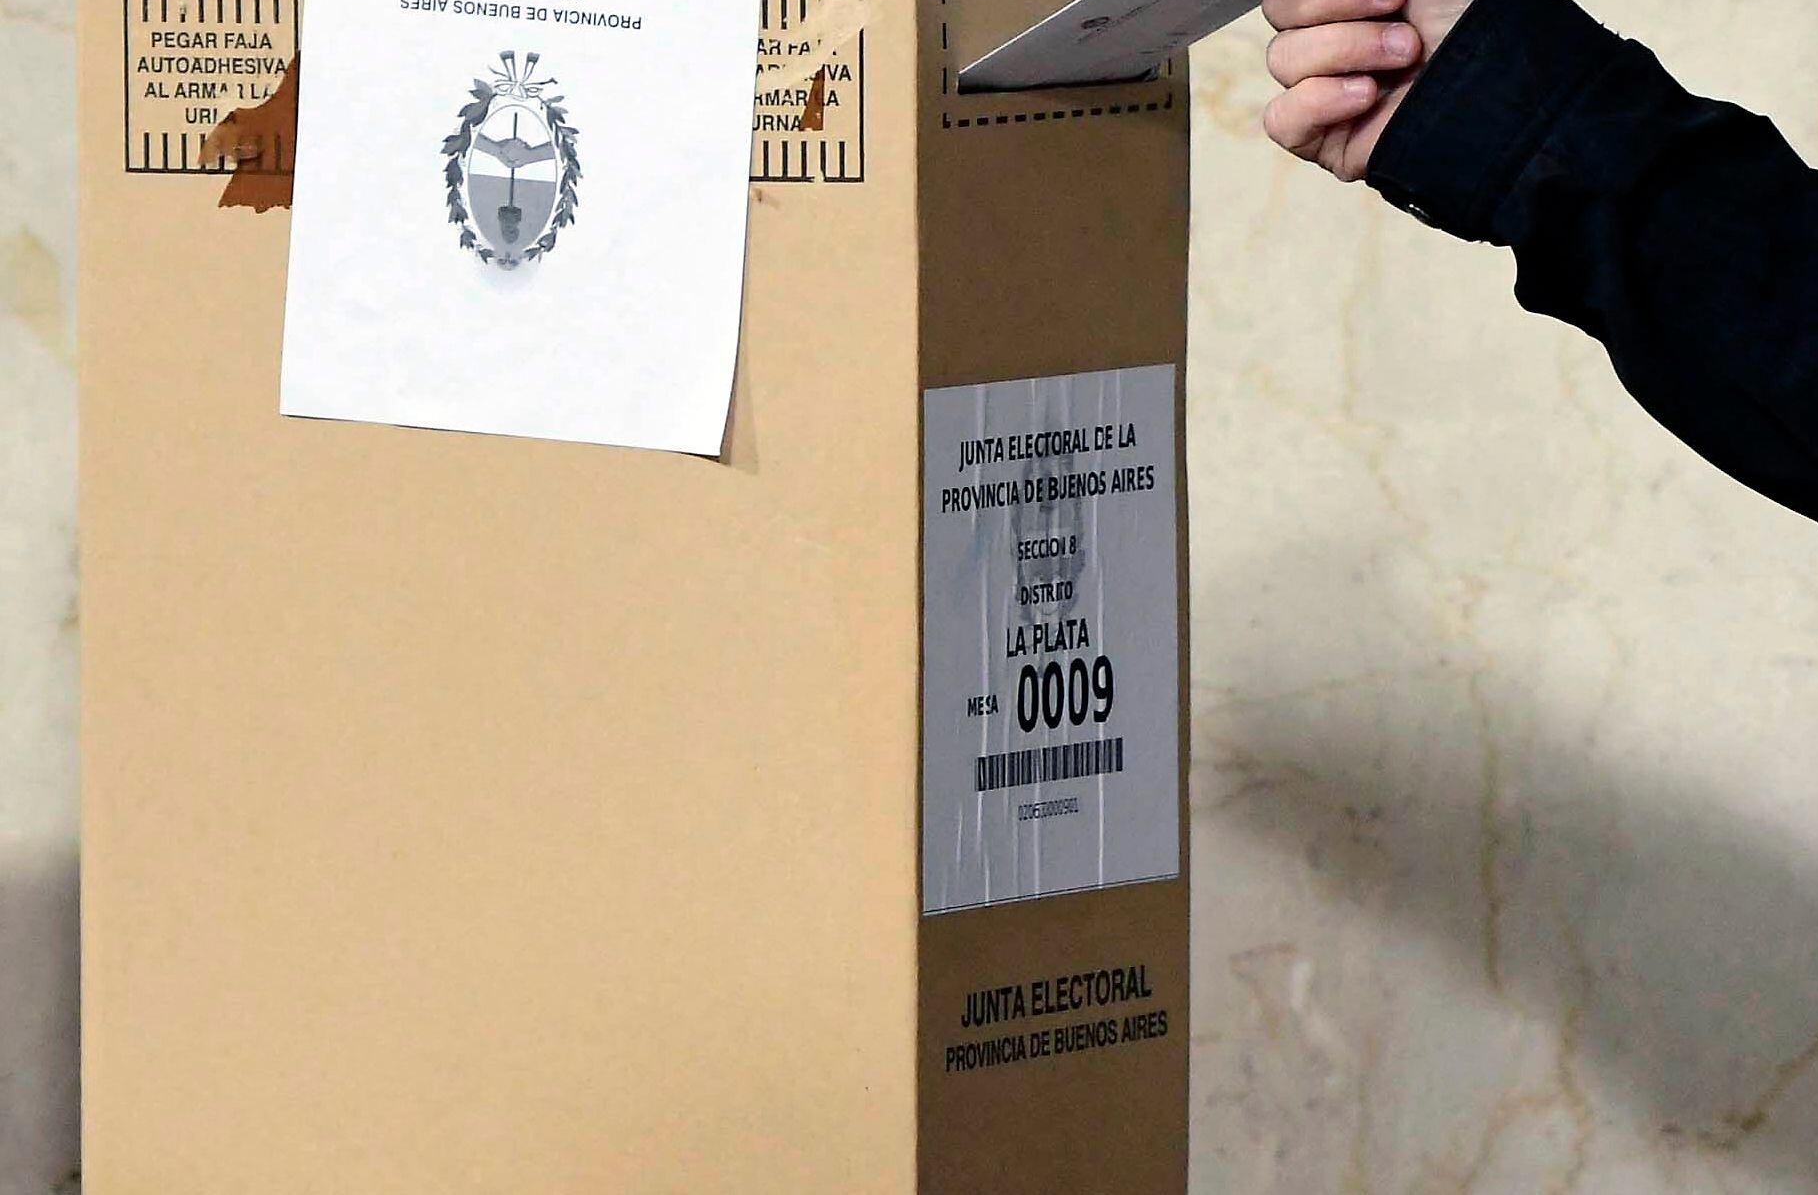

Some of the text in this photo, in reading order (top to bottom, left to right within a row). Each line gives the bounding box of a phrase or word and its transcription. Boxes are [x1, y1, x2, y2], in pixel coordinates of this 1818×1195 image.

[453, 0, 520, 18] BUENOS
[526, 7, 547, 21] DE
[554, 8, 642, 30] PROVINCIA
[151, 32, 273, 49] PEGAR FAJA
[137, 57, 287, 75] AUTOADHESIVA
[144, 82, 169, 99] AL
[959, 423, 1136, 472] JUNTA ELECTORAL DE LA
[942, 465, 1155, 513] PROVINCIA DE BUENOS AIRES
[1020, 581, 1073, 605] DISTRITO
[1007, 618, 1090, 657] LA PLATA
[967, 655, 1114, 733] MESA 0009
[961, 965, 1152, 1027] JUNTA ELECTORAL
[946, 1010, 1168, 1072] PROVINCIA DE BUENOS AIRES
